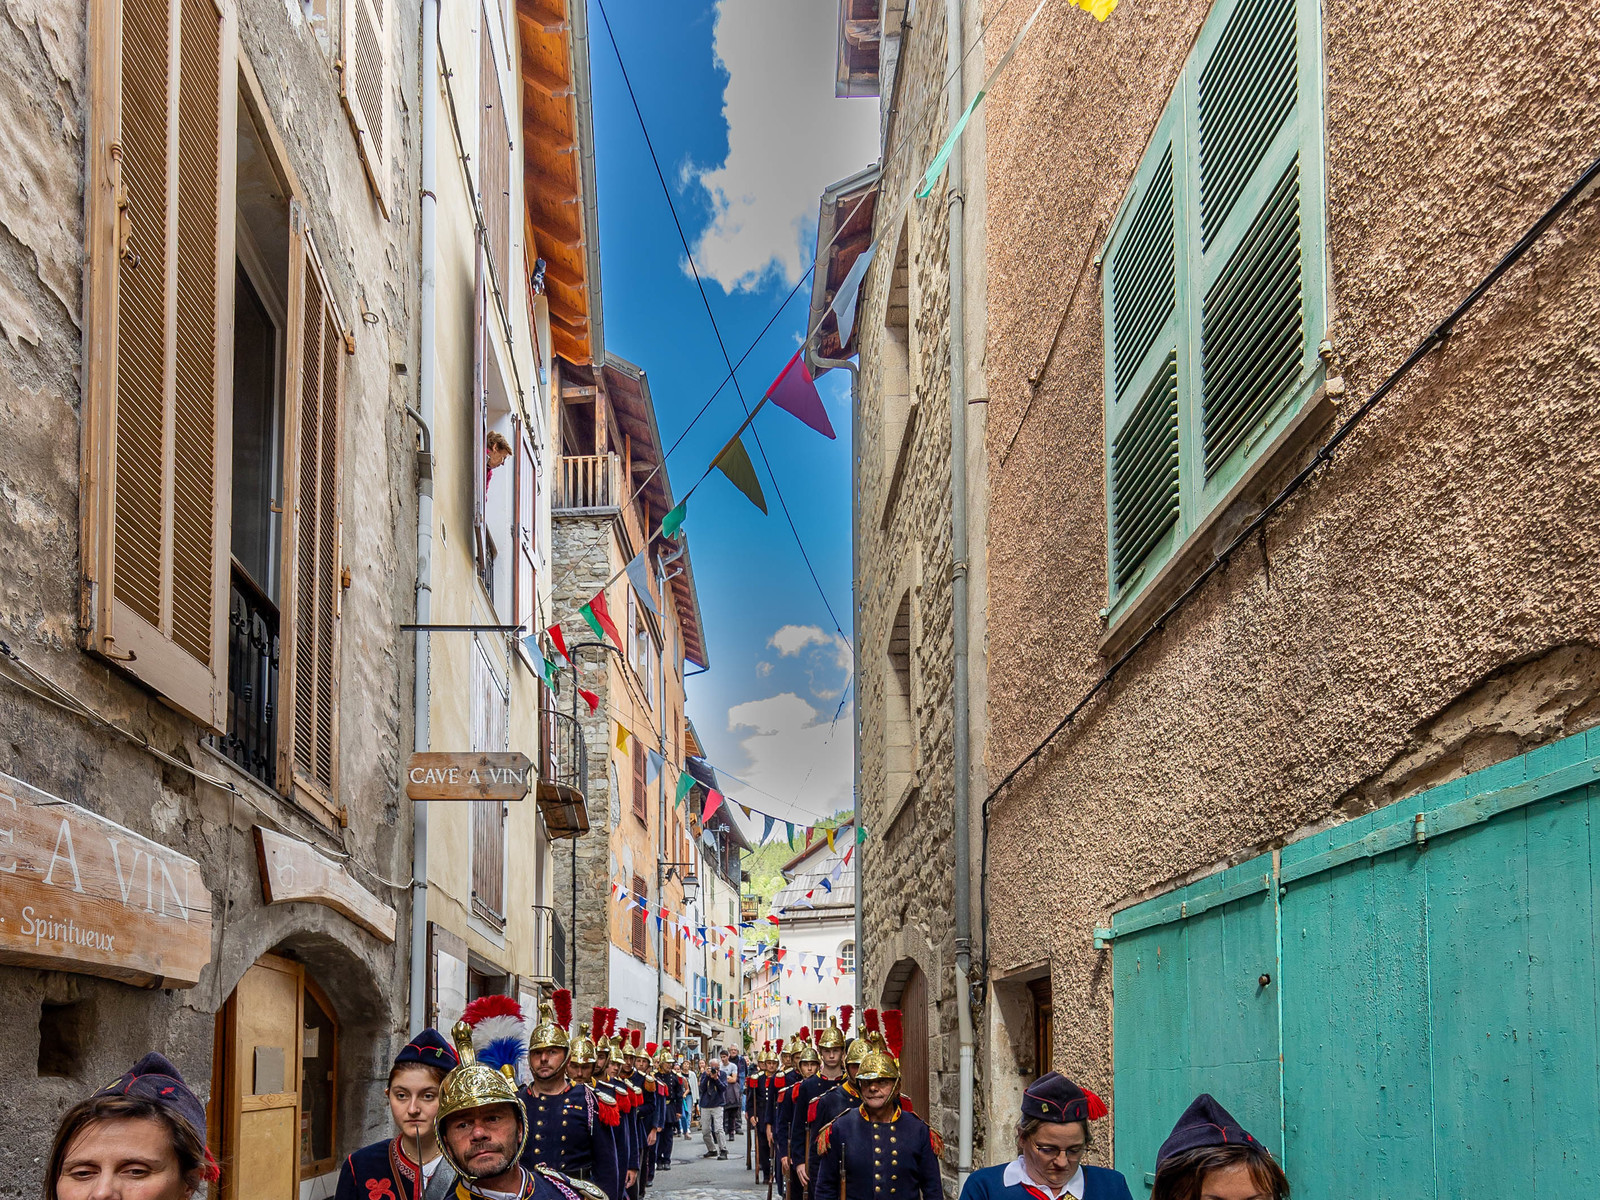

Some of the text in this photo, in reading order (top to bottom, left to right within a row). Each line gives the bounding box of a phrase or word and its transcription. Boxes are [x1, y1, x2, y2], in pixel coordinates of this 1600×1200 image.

[410, 767, 523, 784] CAVE A VIN
[42, 818, 86, 894] A
[106, 837, 190, 925] VIN
[20, 905, 116, 952] Spiritueux
